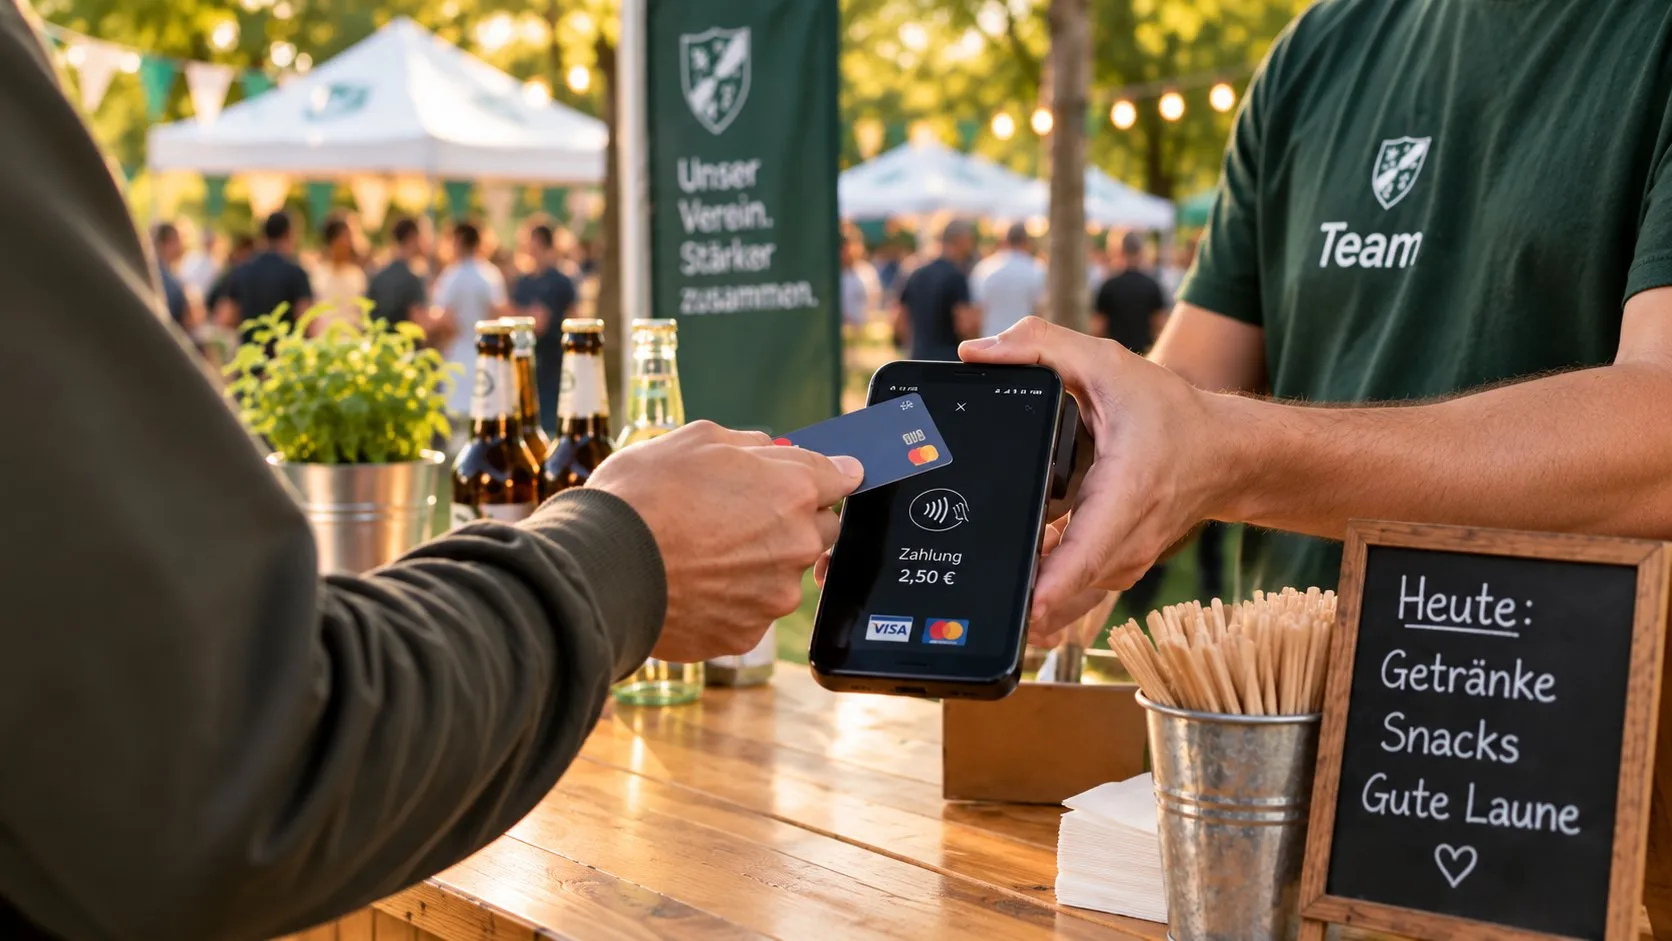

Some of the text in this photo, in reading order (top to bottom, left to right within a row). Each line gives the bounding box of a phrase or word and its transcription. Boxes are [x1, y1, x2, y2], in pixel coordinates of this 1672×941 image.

[677, 157, 760, 193] Unser
[678, 194, 774, 234] Verein.
[680, 238, 776, 276] Stärker
[1319, 221, 1423, 268] Team
[680, 280, 819, 314] zusammen.
[898, 548, 962, 565] Zahlung
[898, 569, 956, 585] 2,50 €
[1398, 575, 1534, 629] Heute:
[872, 622, 907, 636] VISA
[1380, 648, 1557, 704] Getränke
[1380, 711, 1520, 764] Snacks
[1362, 772, 1581, 835] Gute Laune
